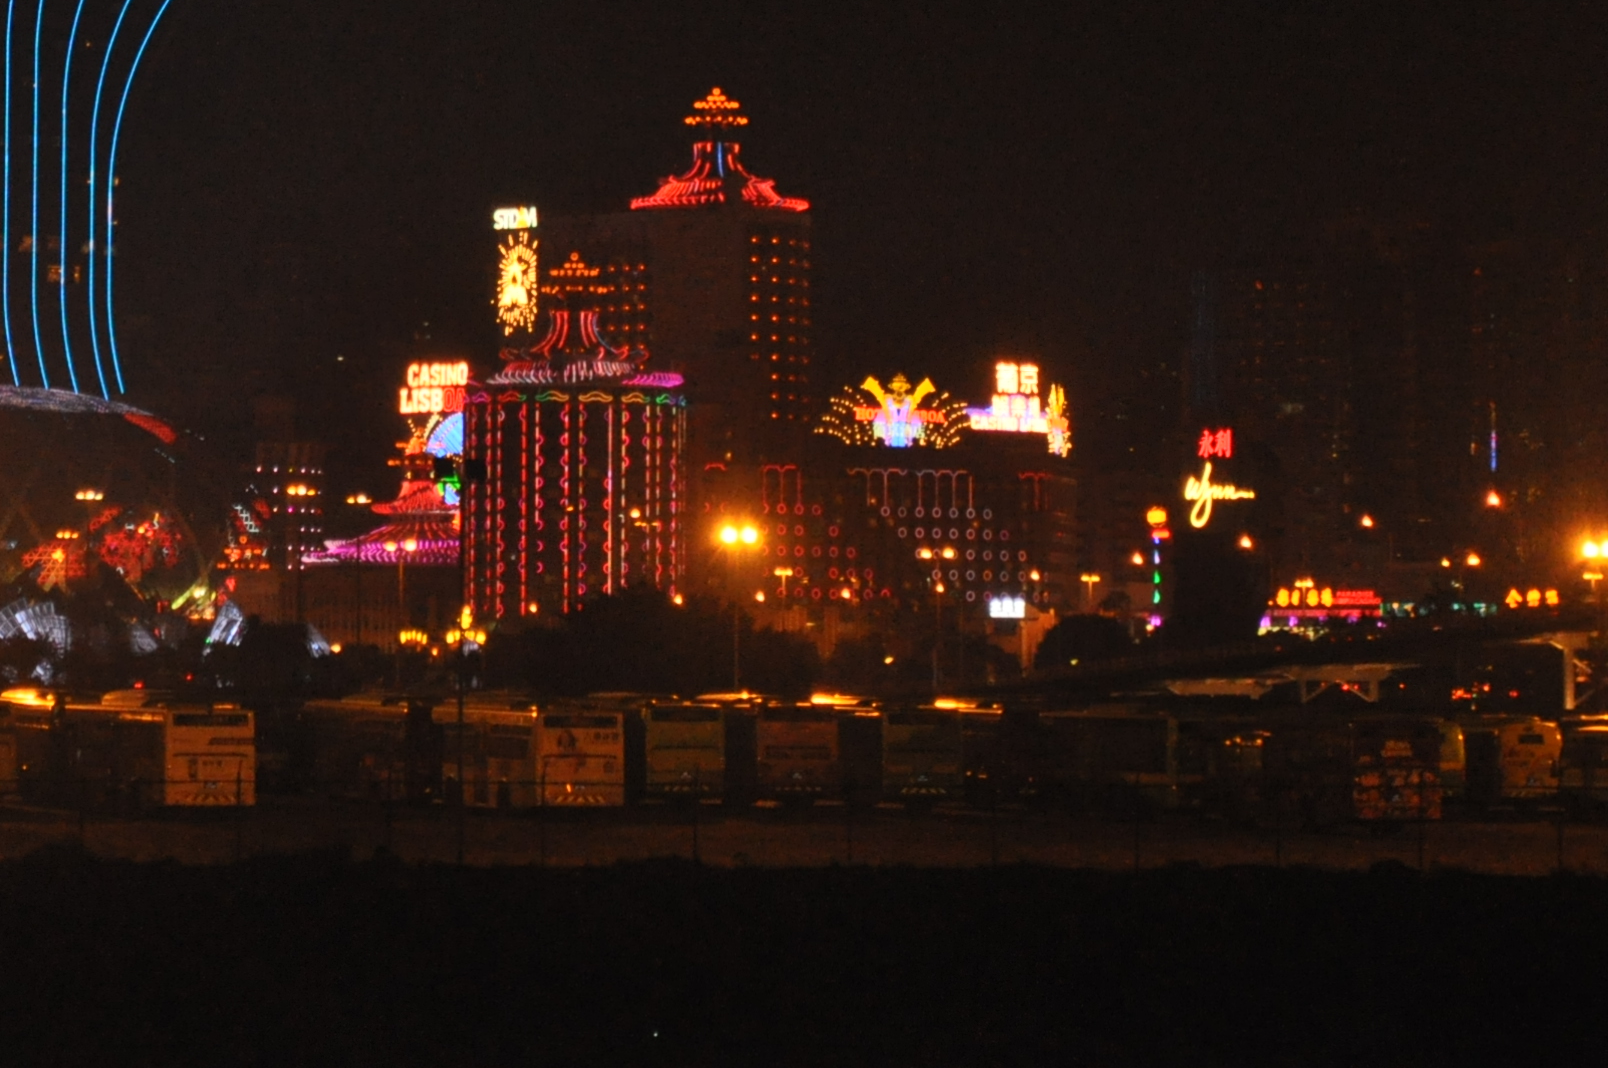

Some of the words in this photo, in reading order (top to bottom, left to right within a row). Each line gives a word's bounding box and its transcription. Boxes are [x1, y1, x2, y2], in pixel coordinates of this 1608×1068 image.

[407, 361, 468, 387] CASINO
[399, 386, 466, 414] LISBOA
[1197, 429, 1233, 458] 永利
